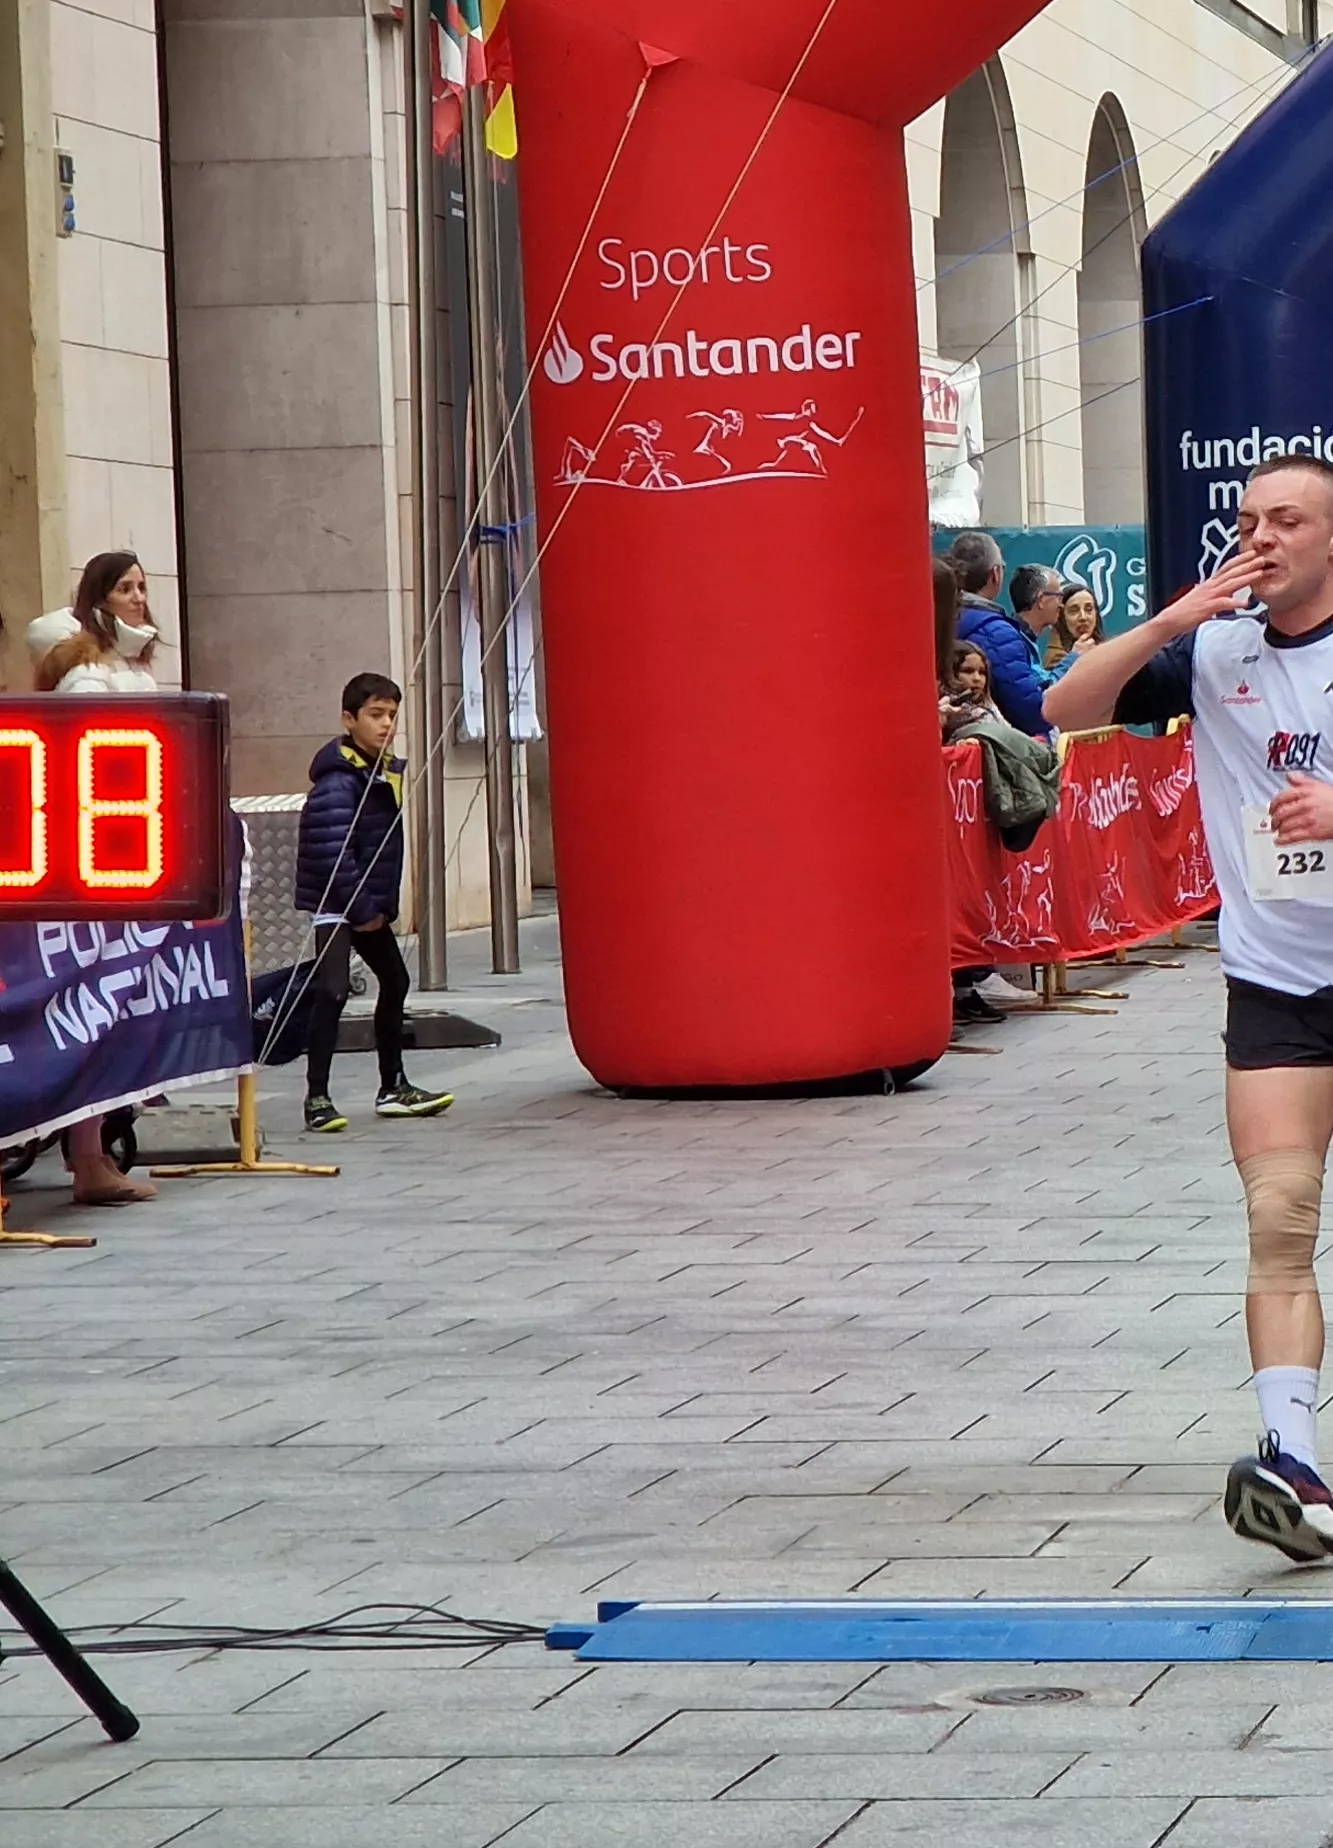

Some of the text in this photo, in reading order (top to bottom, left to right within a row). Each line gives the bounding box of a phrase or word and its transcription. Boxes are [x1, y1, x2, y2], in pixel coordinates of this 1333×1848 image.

[598, 236, 772, 301] Sports
[590, 324, 861, 382] Santander
[1277, 850, 1326, 876] 232
